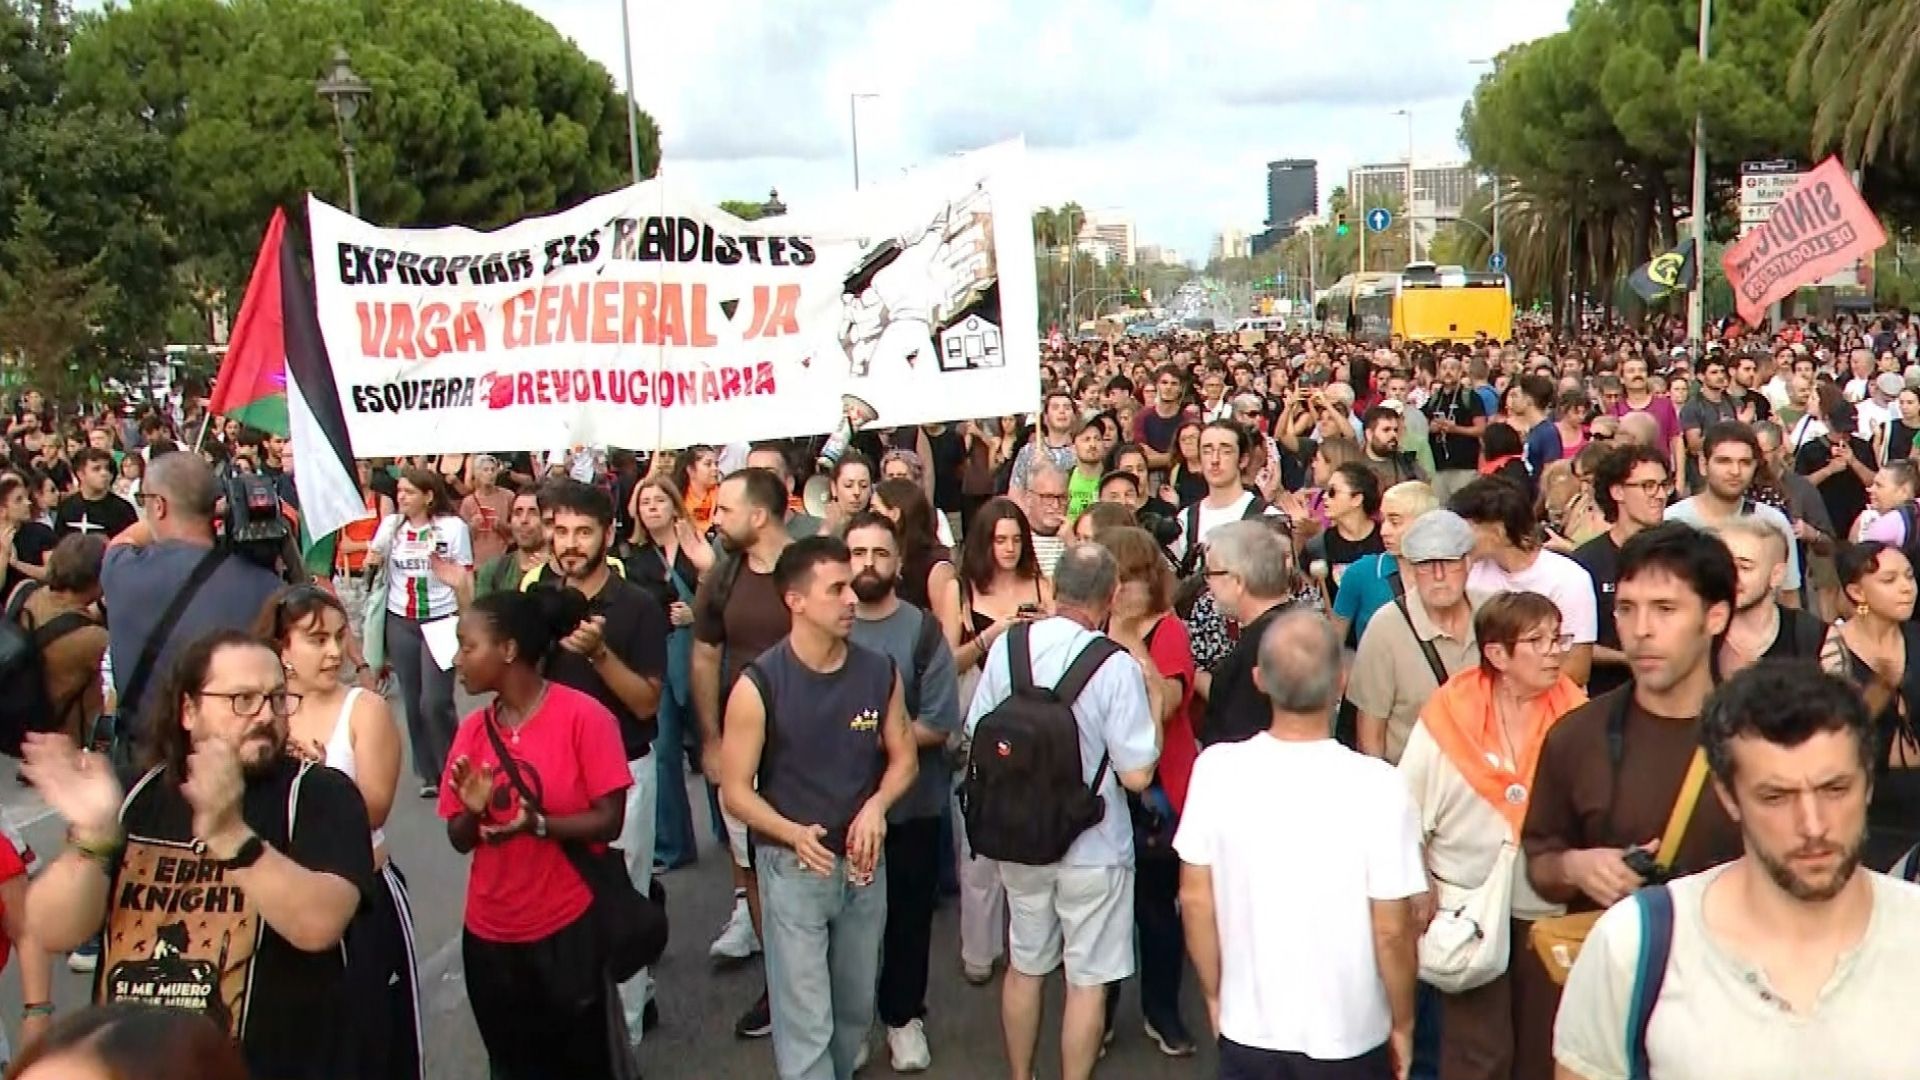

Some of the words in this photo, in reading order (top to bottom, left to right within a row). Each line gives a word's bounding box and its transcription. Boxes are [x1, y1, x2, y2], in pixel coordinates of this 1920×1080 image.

[337, 242, 534, 285] EXPROPIAR
[544, 228, 601, 275] ELS
[356, 301, 487, 360] VAGA
[502, 282, 718, 349] GENERAL
[743, 284, 802, 340] JA
[352, 377, 476, 414] ESQUERRA
[120, 881, 244, 914] KNIGHT
[116, 981, 129, 994] SI
[131, 982, 155, 996] ME
[157, 982, 212, 997] MUERO
